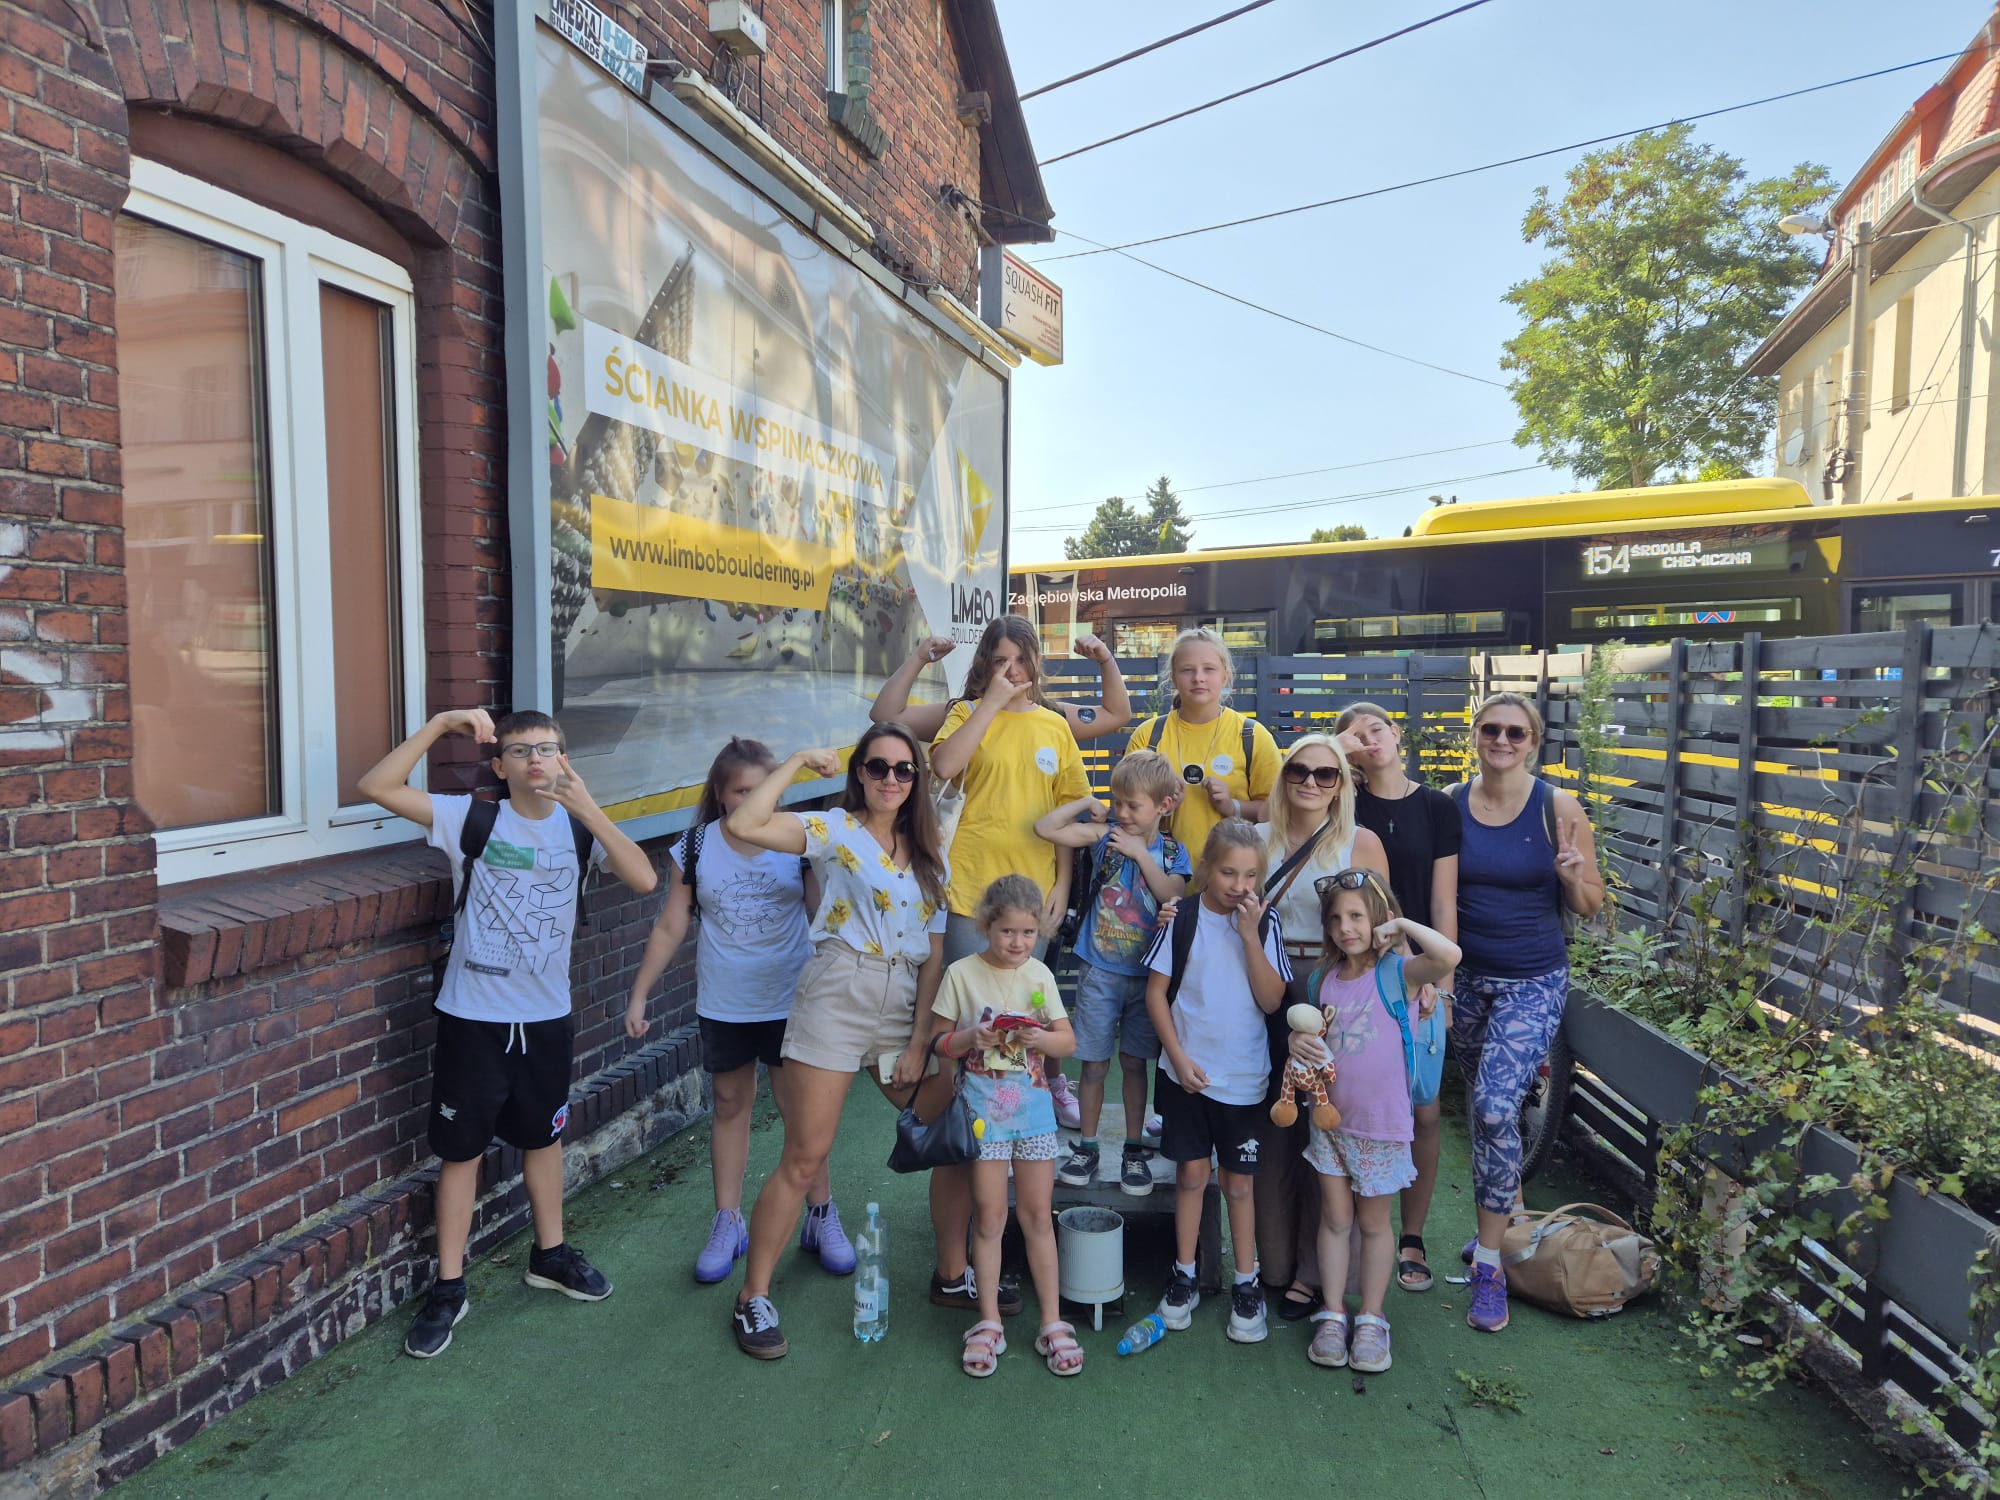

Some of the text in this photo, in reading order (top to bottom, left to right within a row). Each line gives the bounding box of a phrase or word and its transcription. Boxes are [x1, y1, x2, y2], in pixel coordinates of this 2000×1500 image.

[551, 14, 600, 58] BILLBOARDS
[1005, 266, 1058, 316] SQUASH FIT
[604, 345, 884, 492] ŚCIANKA WSPINACZKOWA
[610, 536, 815, 591] www.limbobouldering.pl
[1582, 544, 1631, 575] 154
[1661, 551, 1752, 569] CHEMICZNA
[951, 582, 994, 626] LIMBO
[1008, 583, 1187, 607] Zagłębiowska Metropolia
